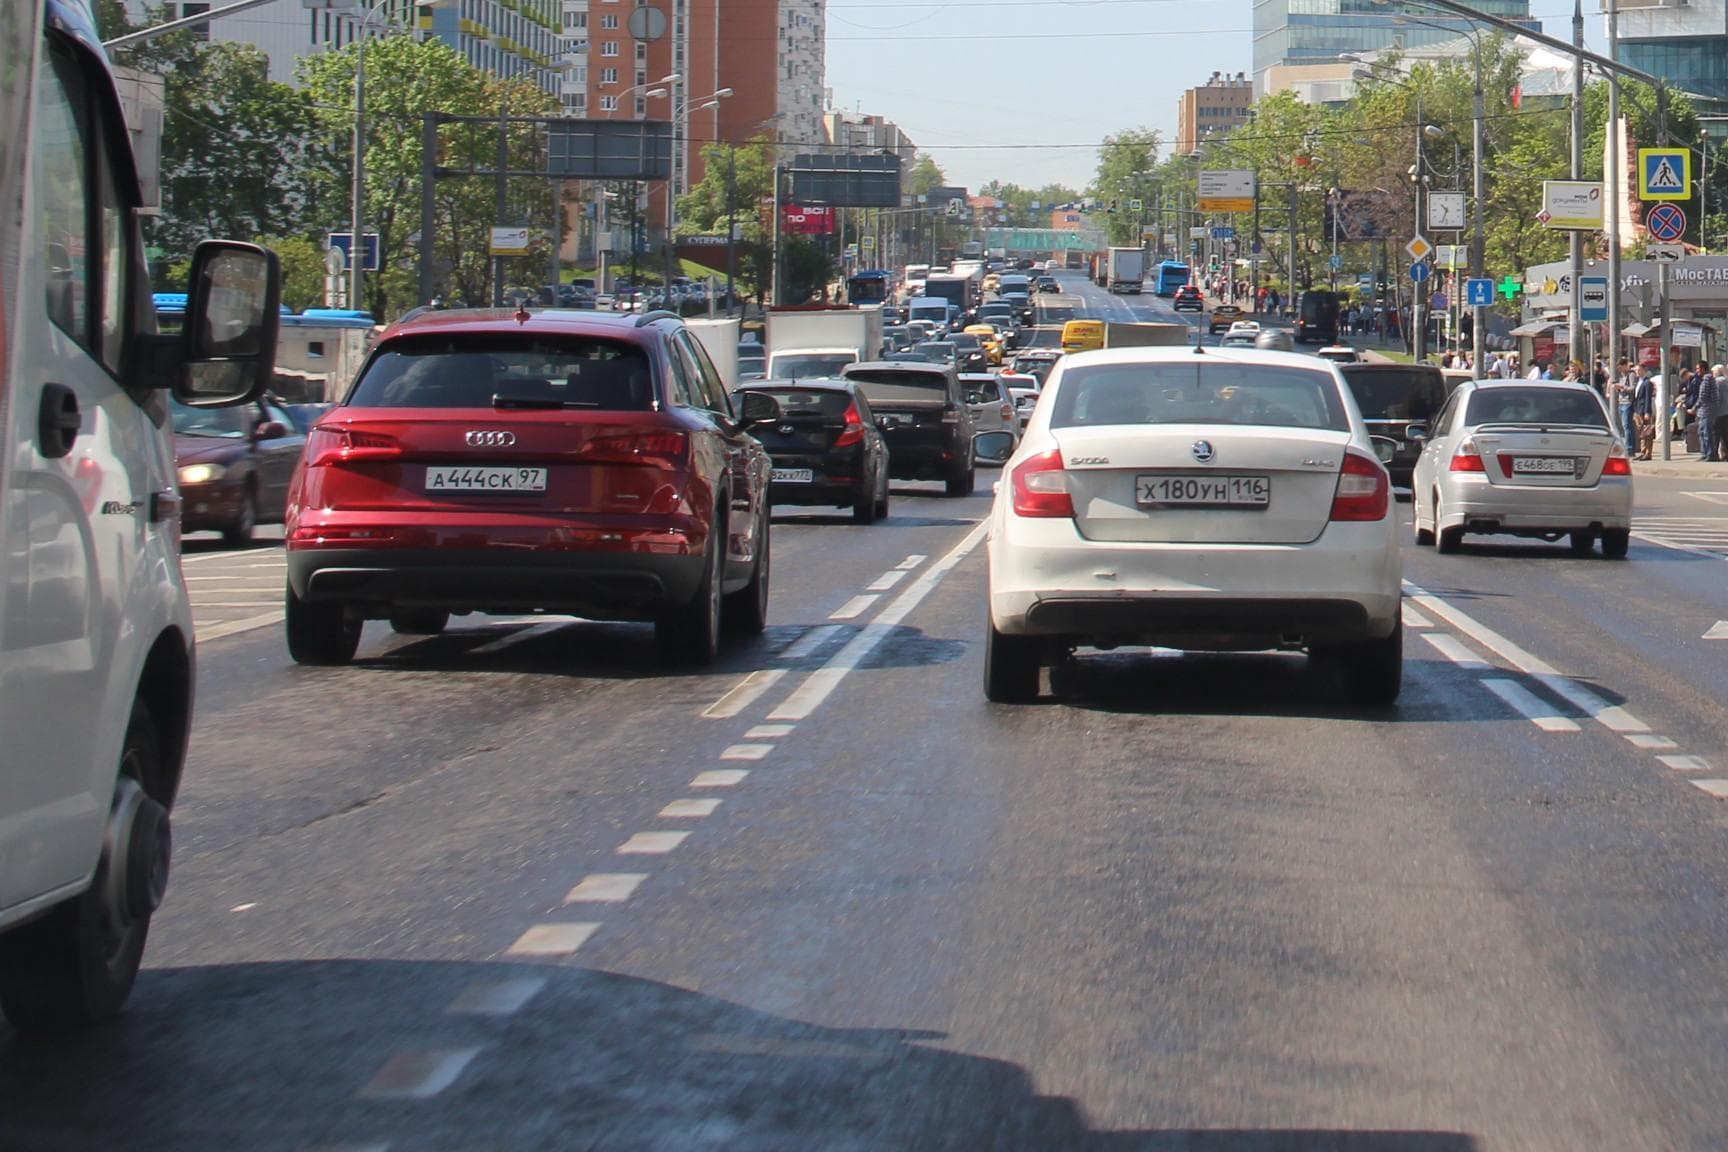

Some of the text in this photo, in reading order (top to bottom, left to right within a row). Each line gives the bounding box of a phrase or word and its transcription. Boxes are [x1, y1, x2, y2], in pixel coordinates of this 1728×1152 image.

[433, 469, 540, 488] А444СК 97
[1143, 479, 1264, 500] Х180УН 116
